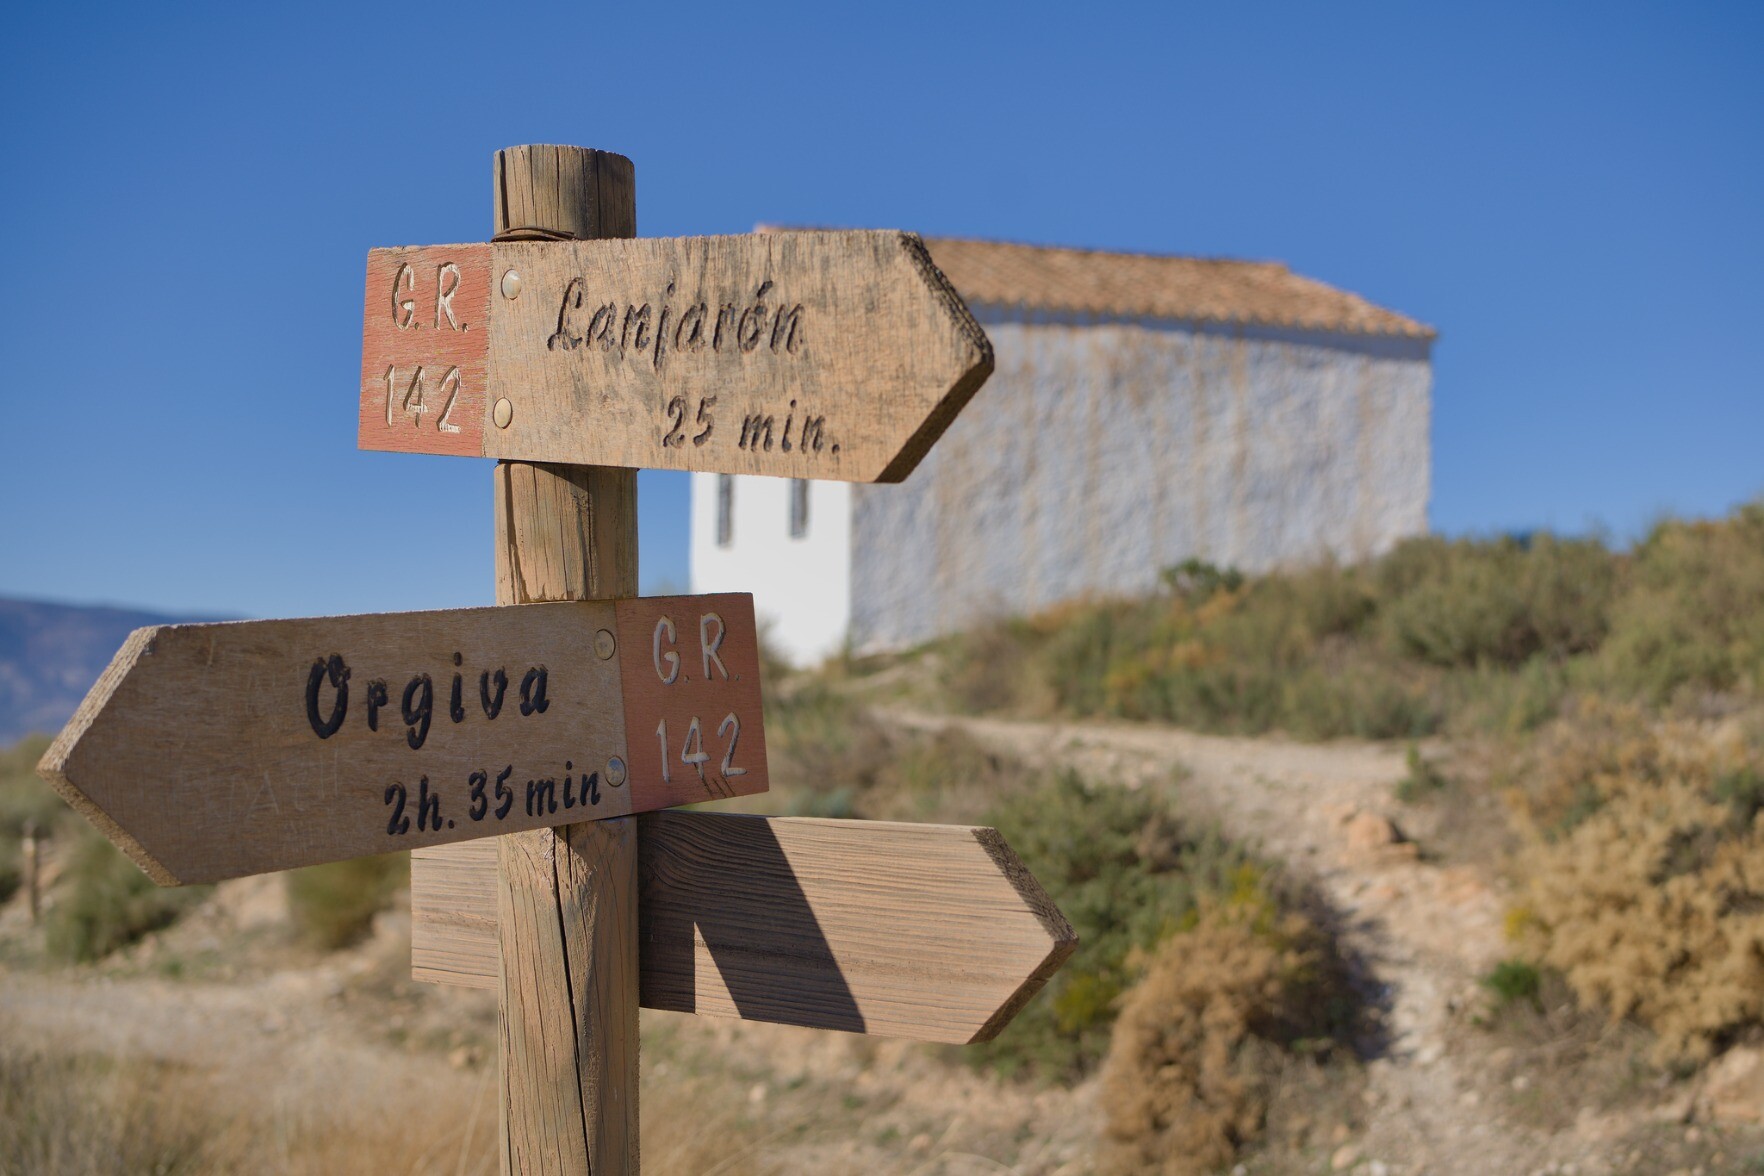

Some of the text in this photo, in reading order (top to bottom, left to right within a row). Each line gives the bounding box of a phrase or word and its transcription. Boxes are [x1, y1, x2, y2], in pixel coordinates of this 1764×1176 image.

[547, 276, 804, 375] Lanjarón
[383, 363, 461, 433] 142
[662, 394, 841, 454] 25 min.
[656, 711, 748, 784] 142
